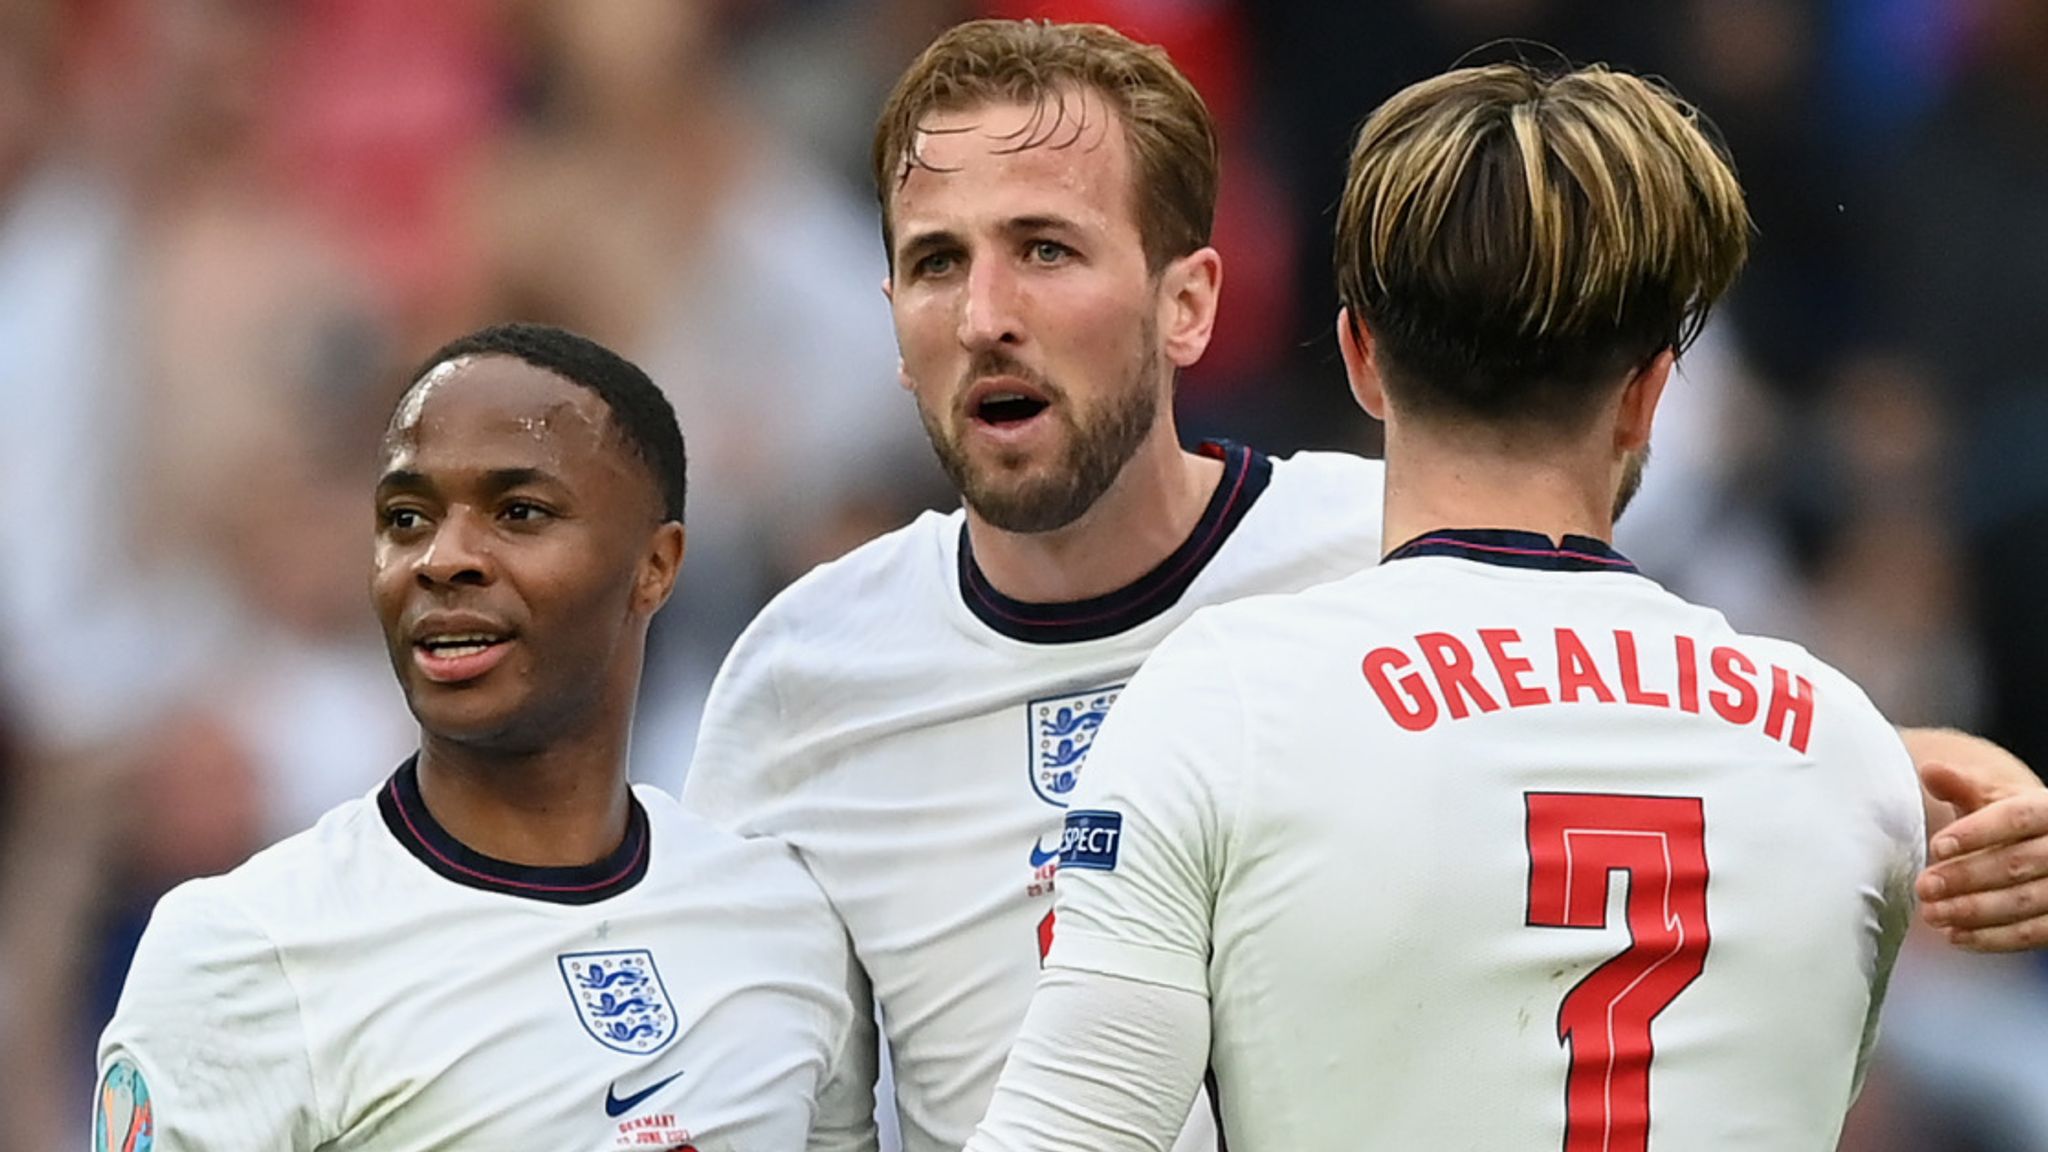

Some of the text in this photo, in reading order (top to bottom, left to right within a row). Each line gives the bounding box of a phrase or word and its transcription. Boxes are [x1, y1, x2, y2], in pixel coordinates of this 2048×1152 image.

[1362, 628, 1815, 754] GREALISH
[1059, 827, 1118, 854] SPECT
[1523, 791, 1711, 1152] 7
[619, 1115, 675, 1133] GERMANY
